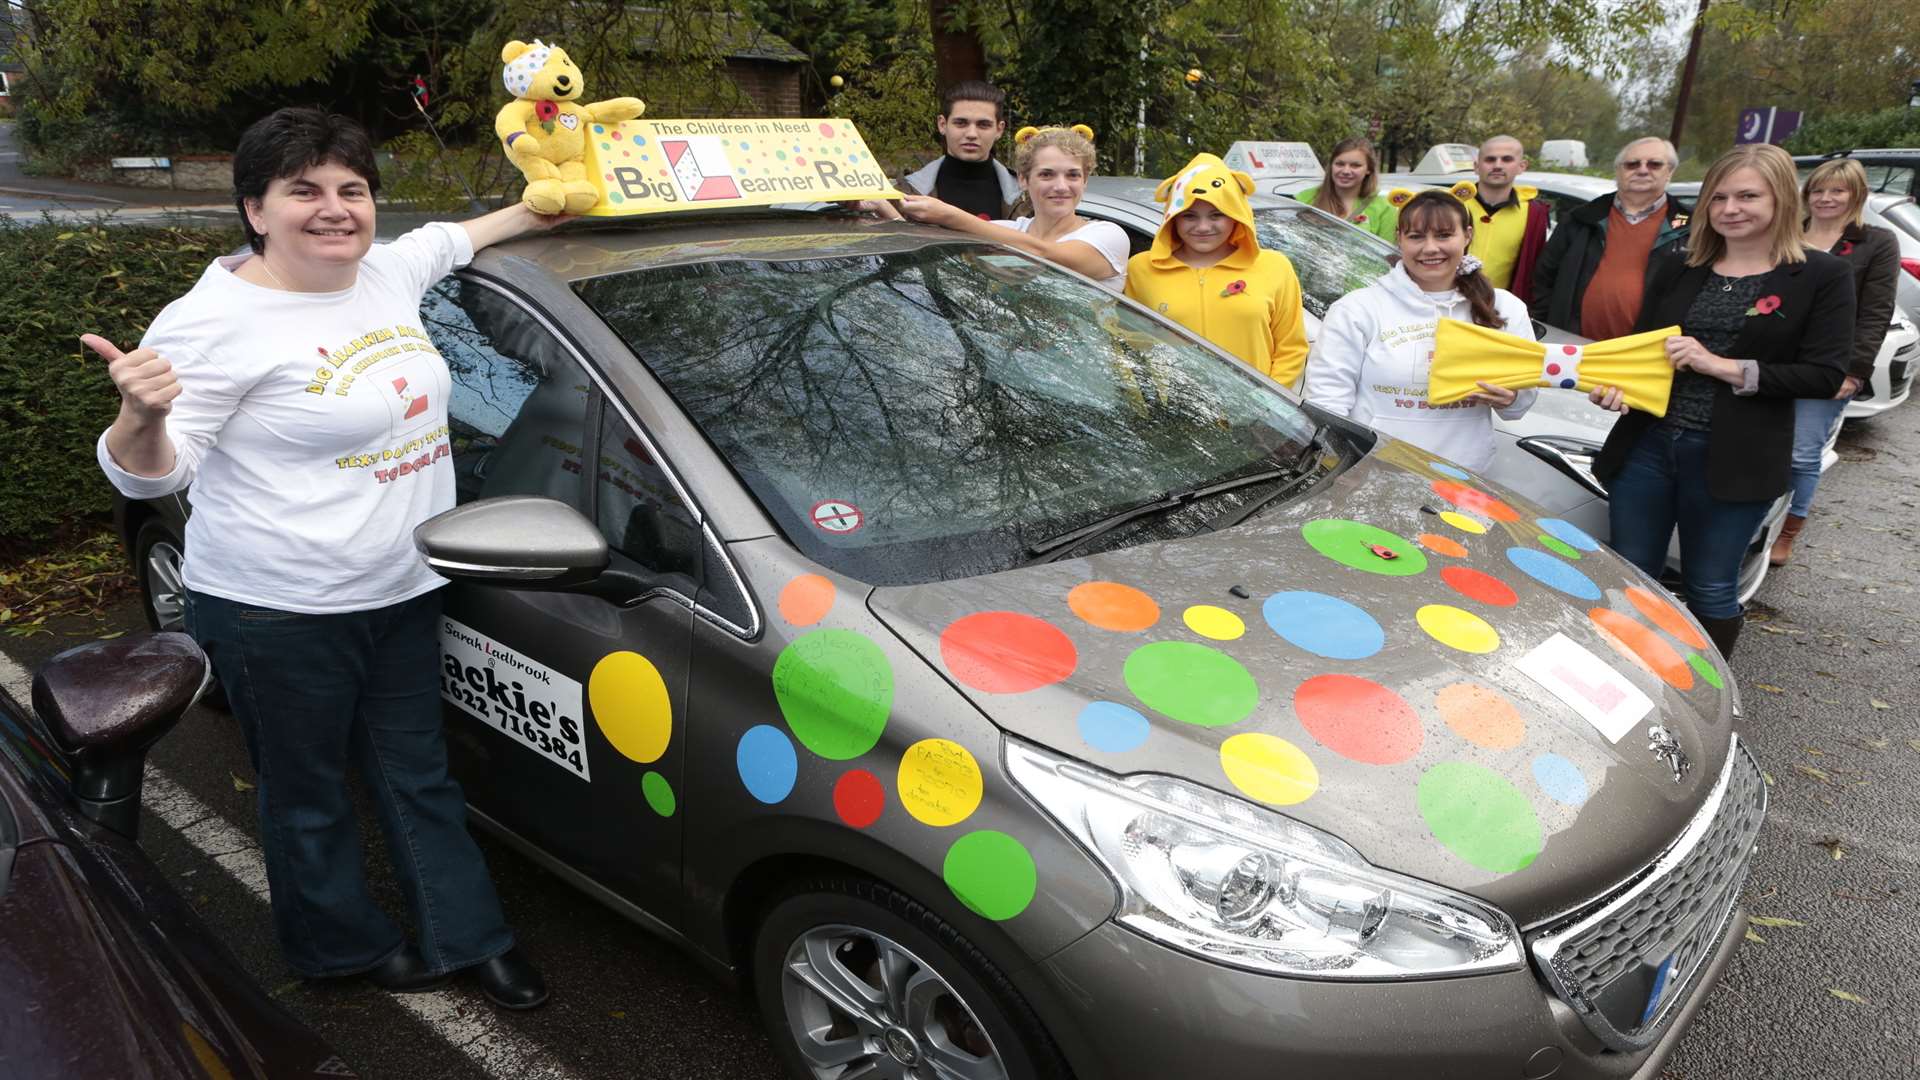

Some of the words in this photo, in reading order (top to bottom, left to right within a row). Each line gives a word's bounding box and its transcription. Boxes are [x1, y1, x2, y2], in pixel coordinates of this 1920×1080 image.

[651, 122, 682, 135] The
[687, 121, 752, 135] Children
[756, 122, 770, 133] in
[772, 121, 811, 133] Need
[614, 166, 677, 202] Big
[814, 160, 885, 192] Relay
[305, 366, 333, 396] BIG
[327, 328, 395, 368] LEARNER
[336, 452, 380, 469] TEXT
[444, 622, 482, 651] Sarah
[484, 642, 551, 686] Ladbrook
[440, 674, 490, 718] 1622
[494, 704, 583, 773] 716384
[443, 653, 580, 745] ackie's
